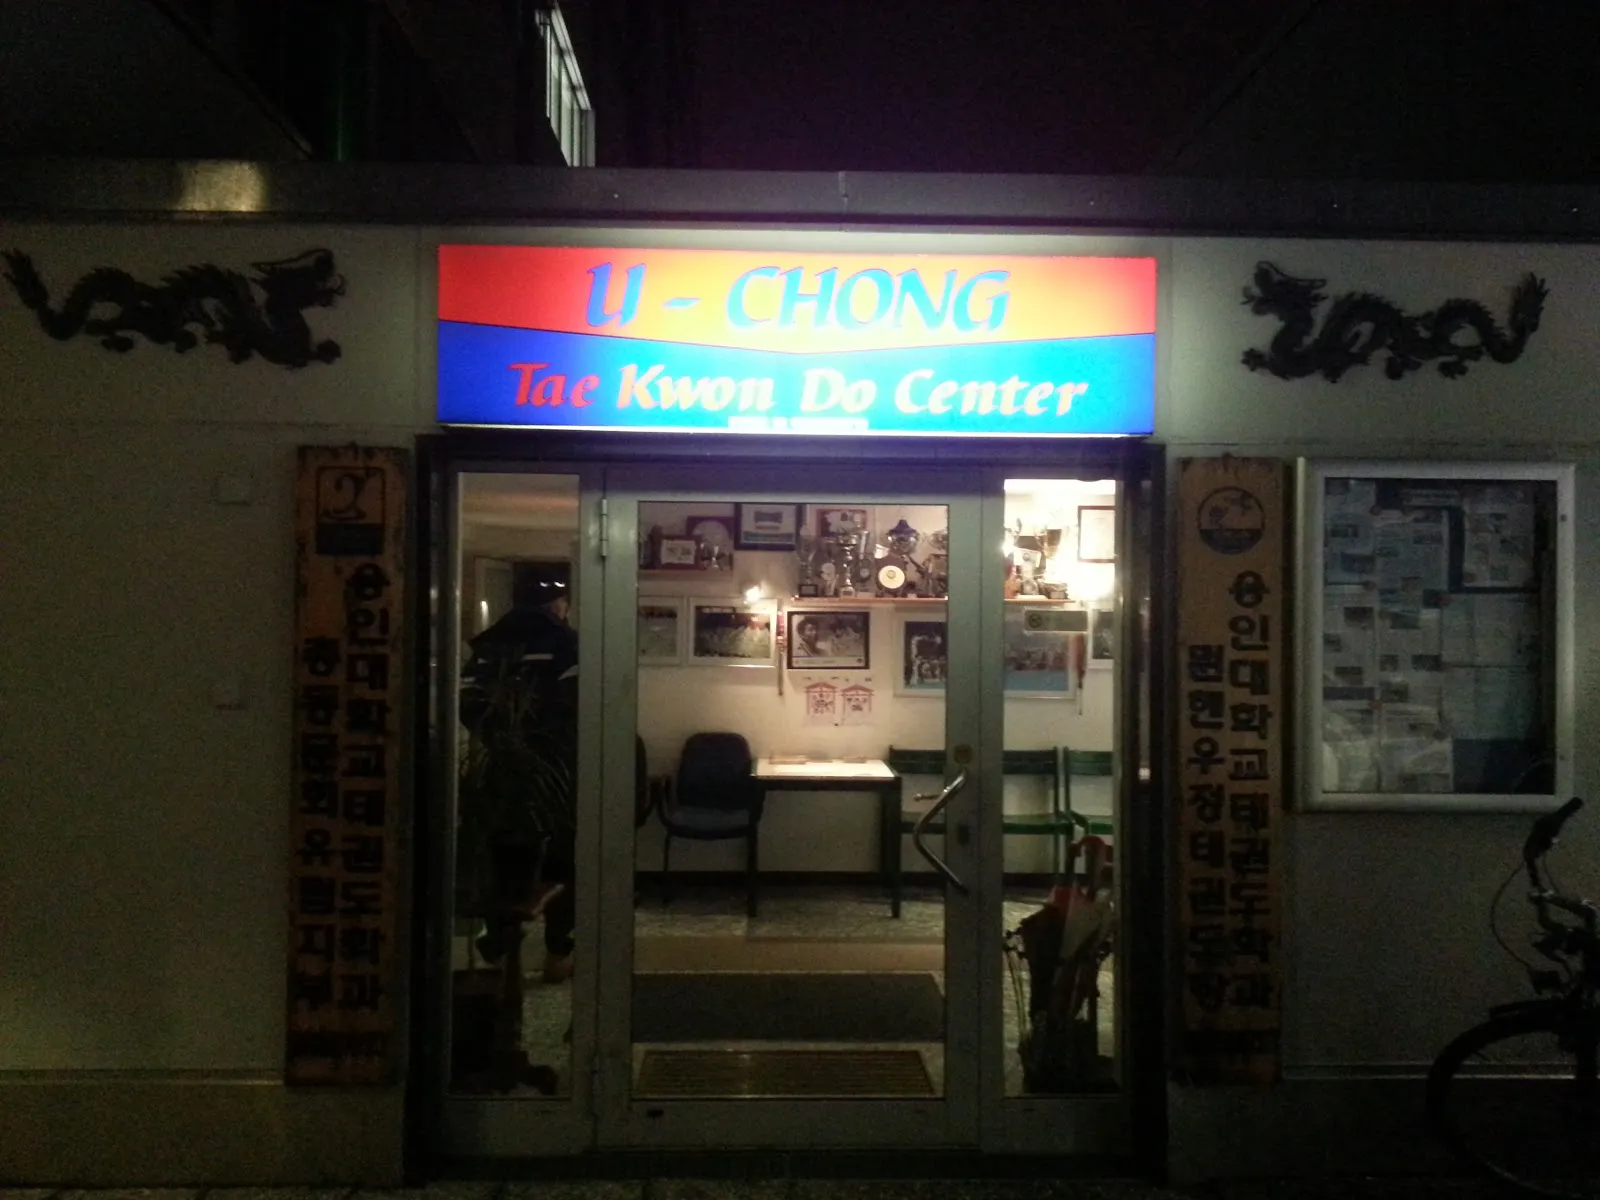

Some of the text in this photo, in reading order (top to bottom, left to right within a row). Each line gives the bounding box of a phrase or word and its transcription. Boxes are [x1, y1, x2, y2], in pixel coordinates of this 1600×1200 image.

[586, 262, 648, 328] U
[726, 266, 1010, 331] CHONG
[508, 362, 1089, 417] Tae Kwon Do Center
